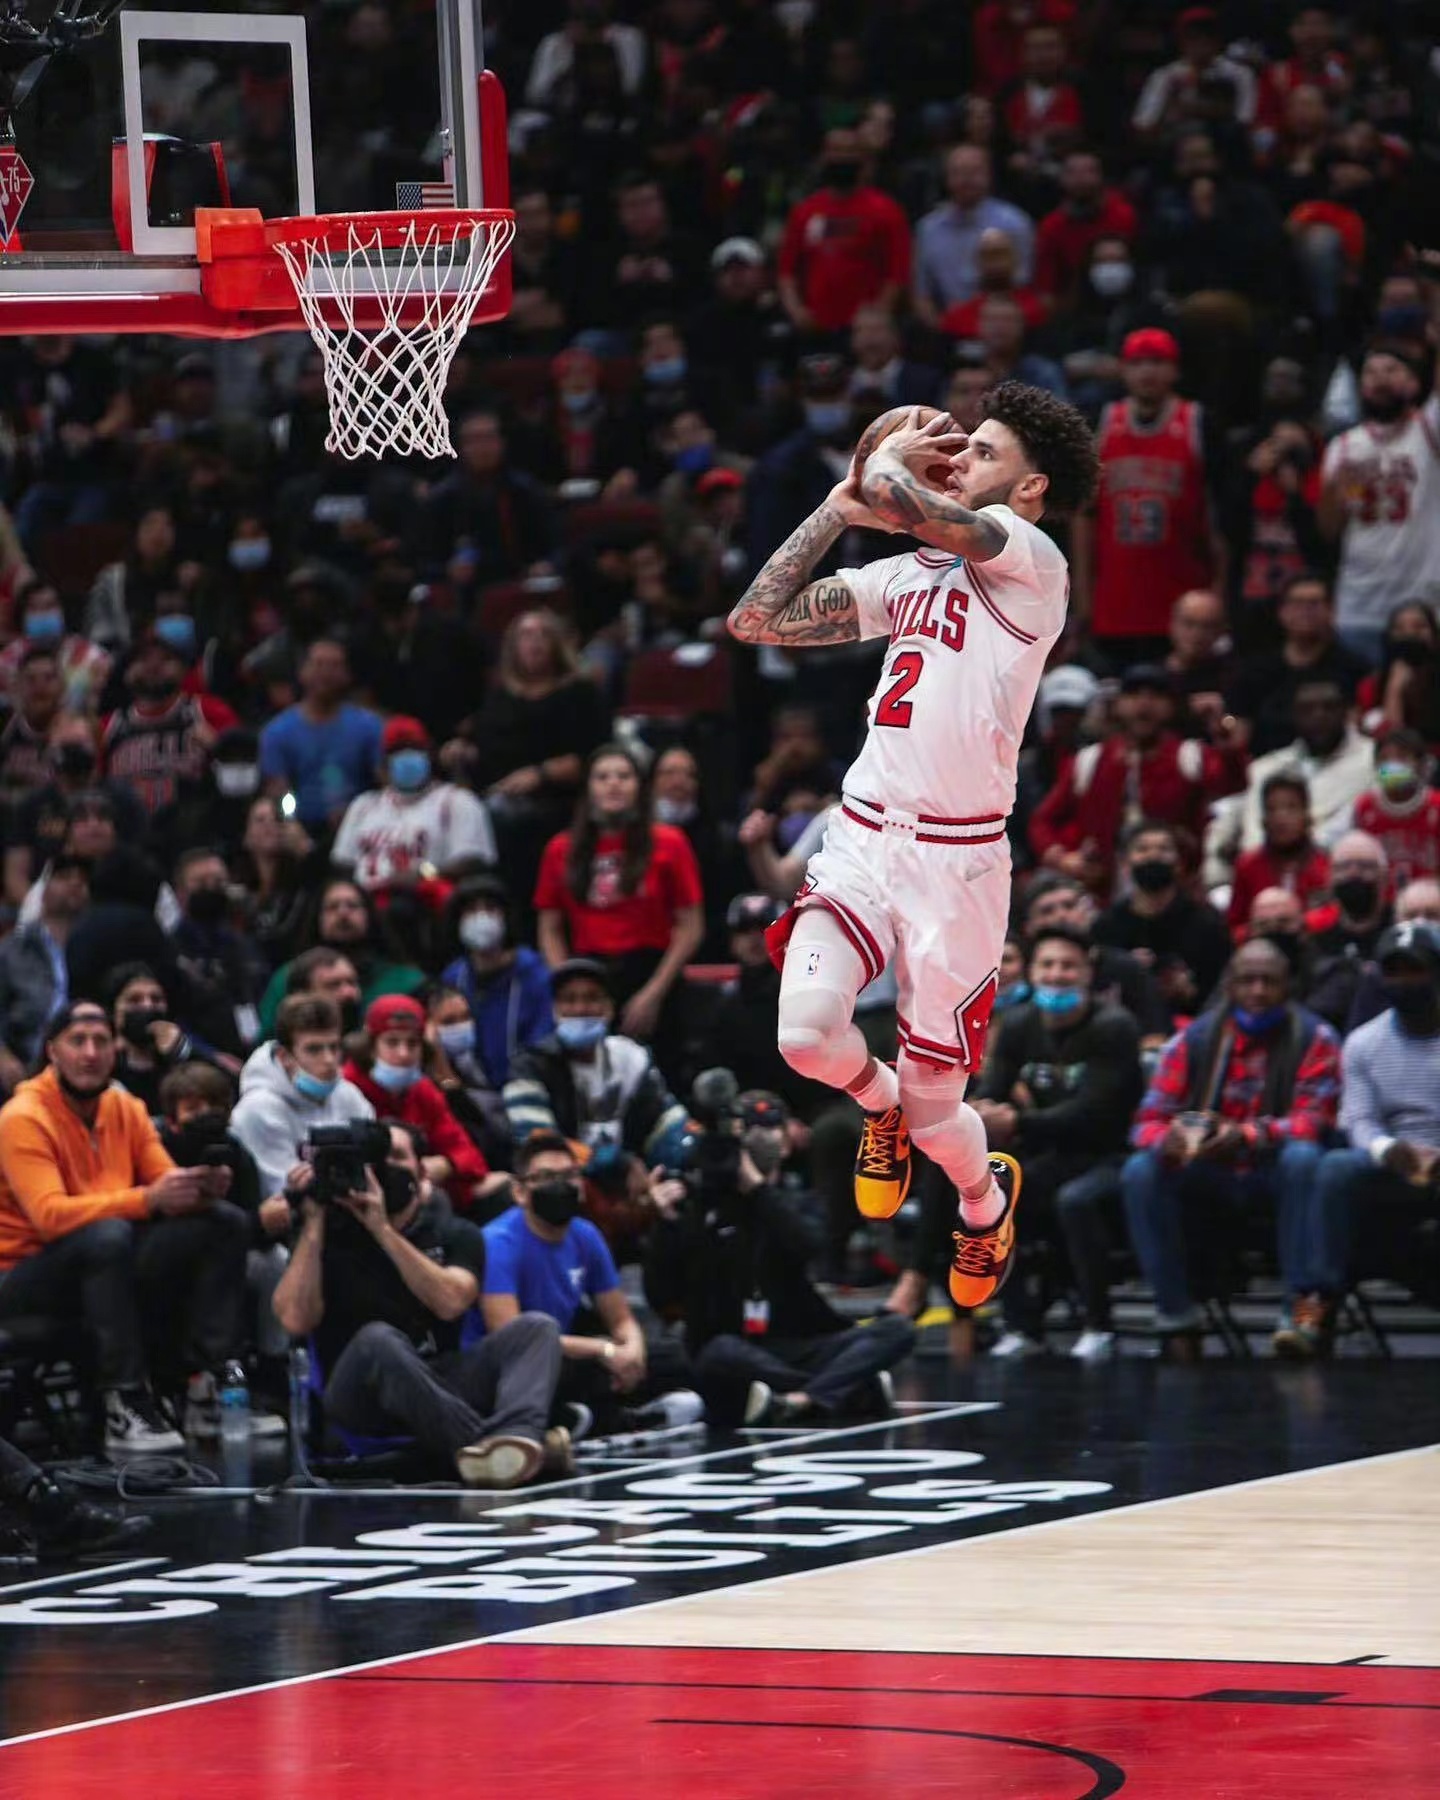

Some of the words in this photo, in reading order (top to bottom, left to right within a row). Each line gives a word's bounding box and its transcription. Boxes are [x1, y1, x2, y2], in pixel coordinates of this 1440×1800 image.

[7, 166, 20, 193] 75
[815, 584, 851, 618] GOD
[888, 585, 970, 653] ULLS
[874, 651, 924, 729] 2
[0, 1449, 986, 1625] CHICAGO
[329, 1479, 1114, 1604] BULLS
